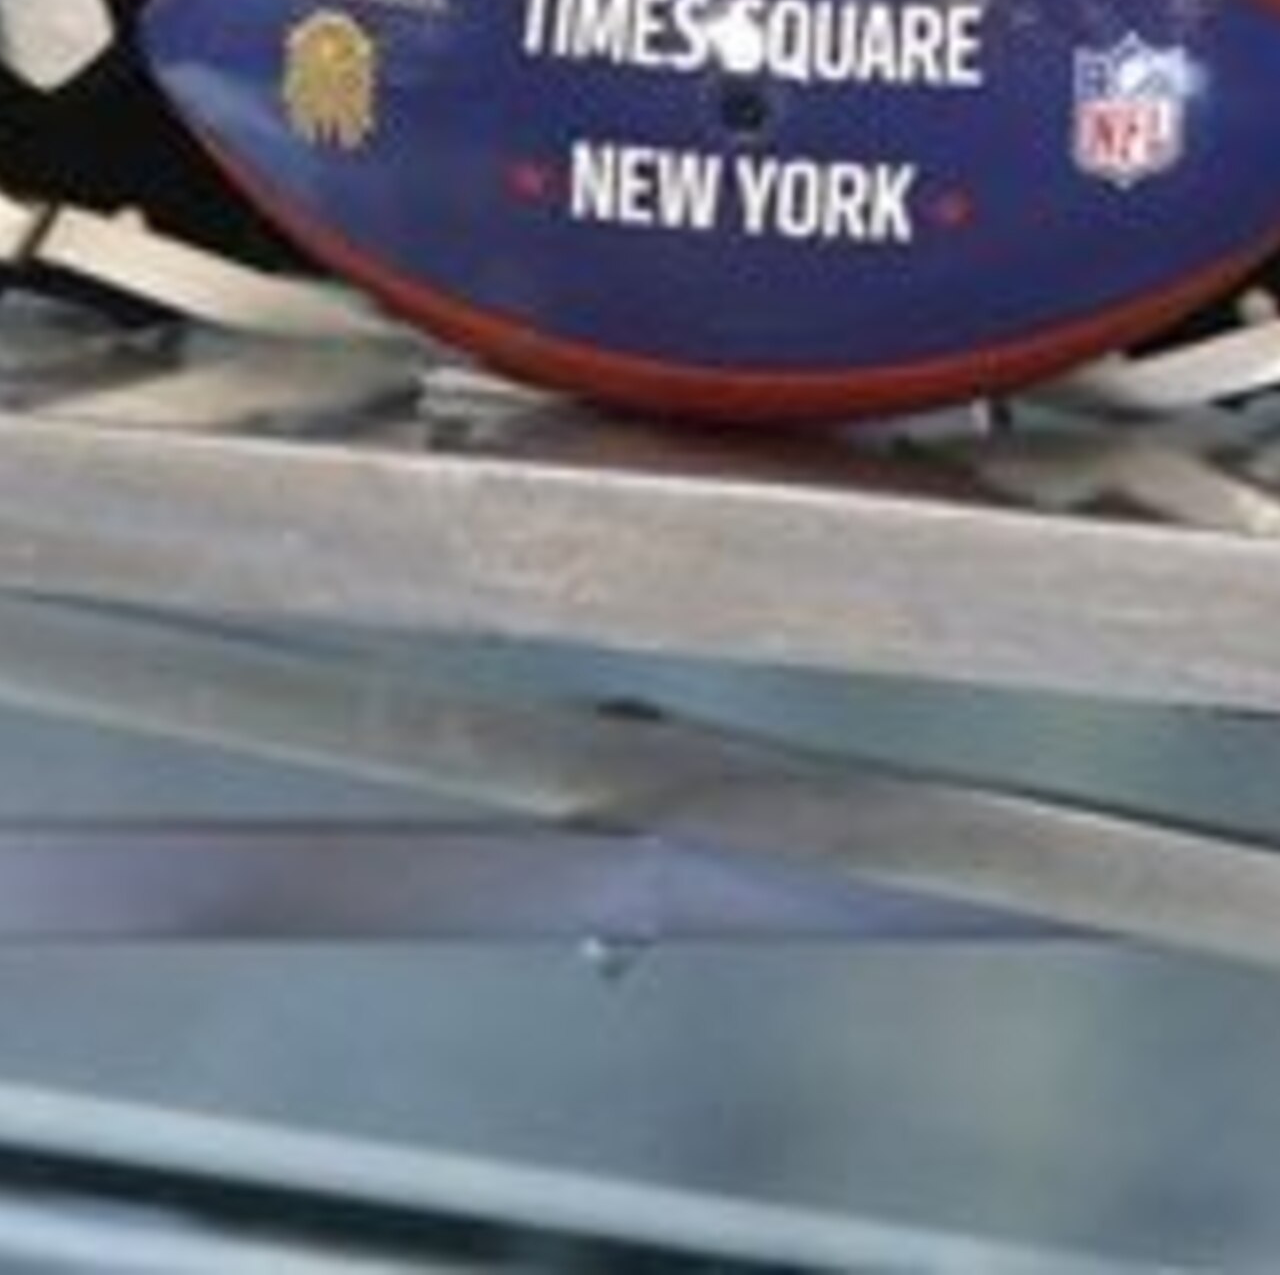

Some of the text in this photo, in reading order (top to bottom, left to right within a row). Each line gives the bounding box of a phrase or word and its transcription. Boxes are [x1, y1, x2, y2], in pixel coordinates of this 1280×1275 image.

[1080, 103, 1172, 163] NFL
[572, 142, 915, 242] NEW YORK
